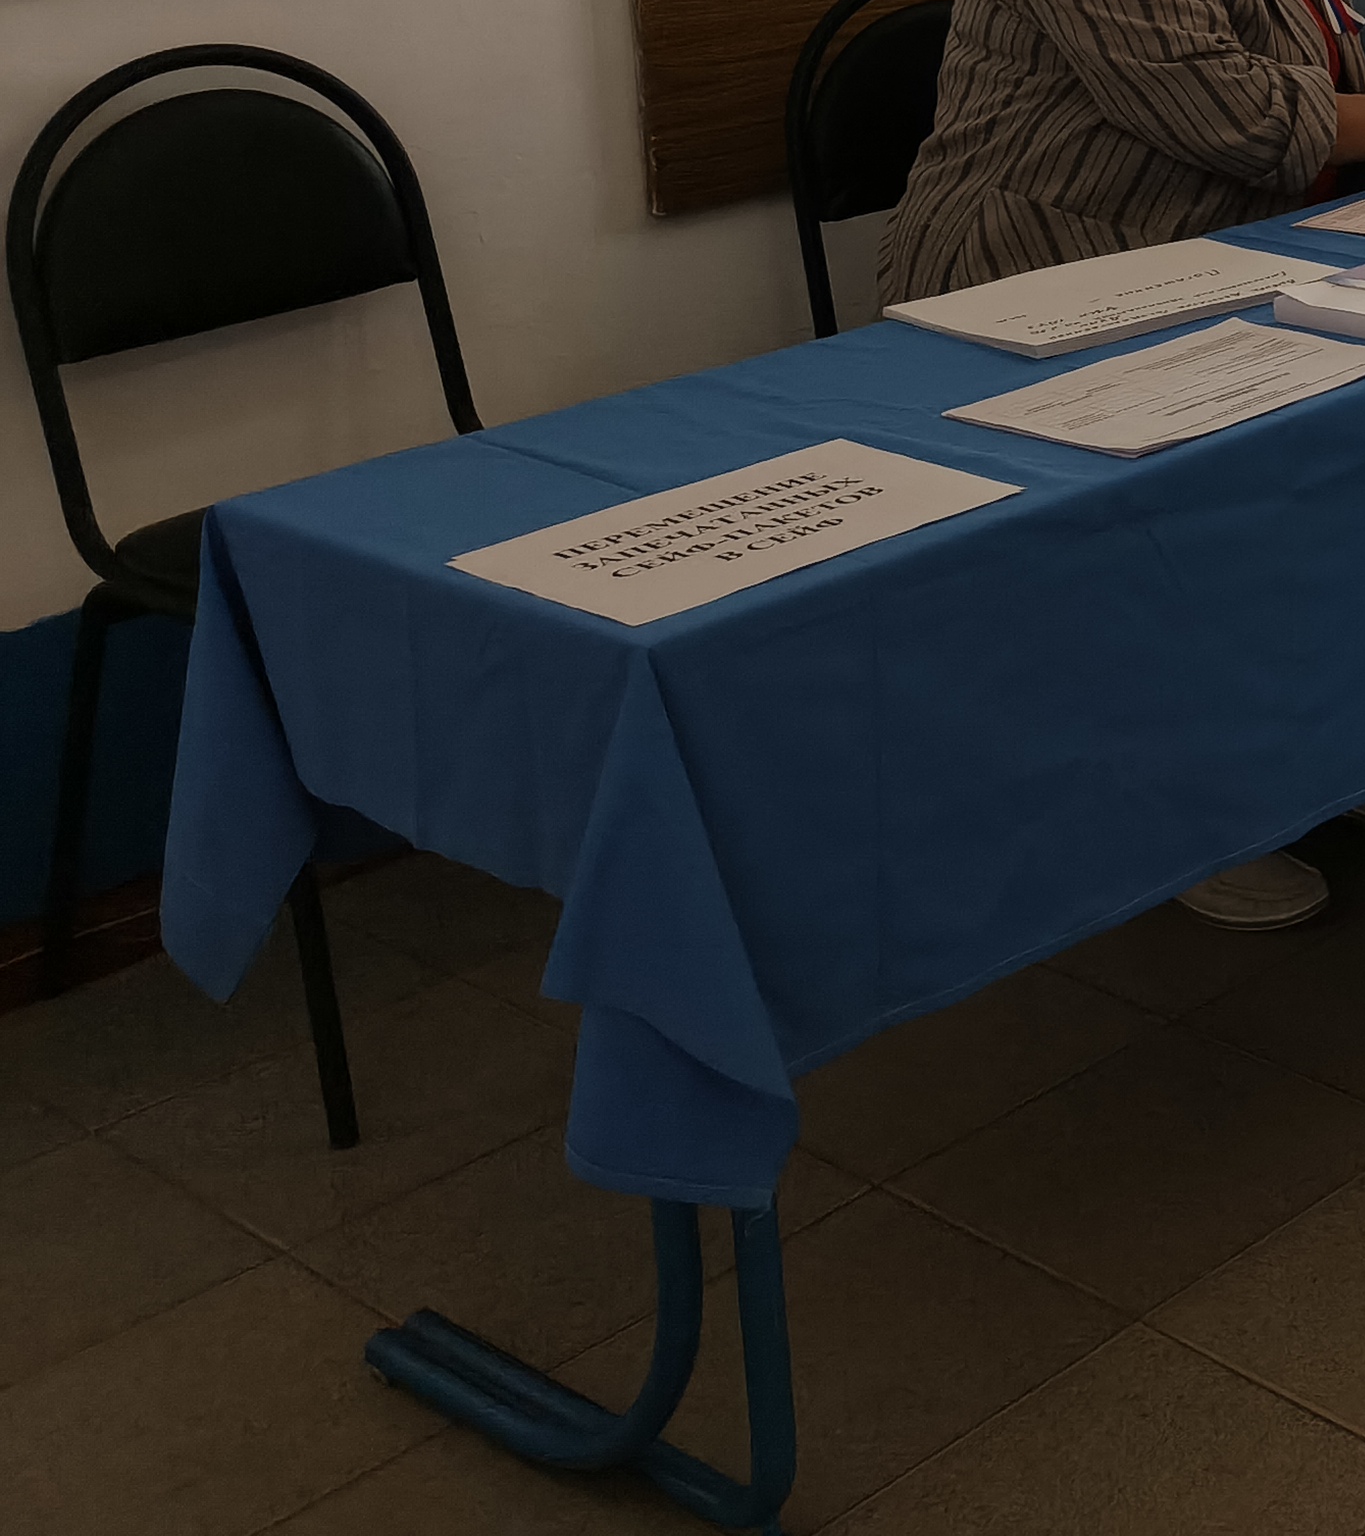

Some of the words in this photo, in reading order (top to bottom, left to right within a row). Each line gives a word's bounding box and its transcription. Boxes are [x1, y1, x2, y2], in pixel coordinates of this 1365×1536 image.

[551, 472, 828, 560] ПЕРЕМЕЩЕНИЕ
[571, 476, 865, 572] ЗАПЕЧАТАННЫХ
[611, 485, 885, 579] СЕЙФ-ПАКЕТОВ
[714, 550, 744, 563] В
[746, 517, 845, 553] СЕЙФ
